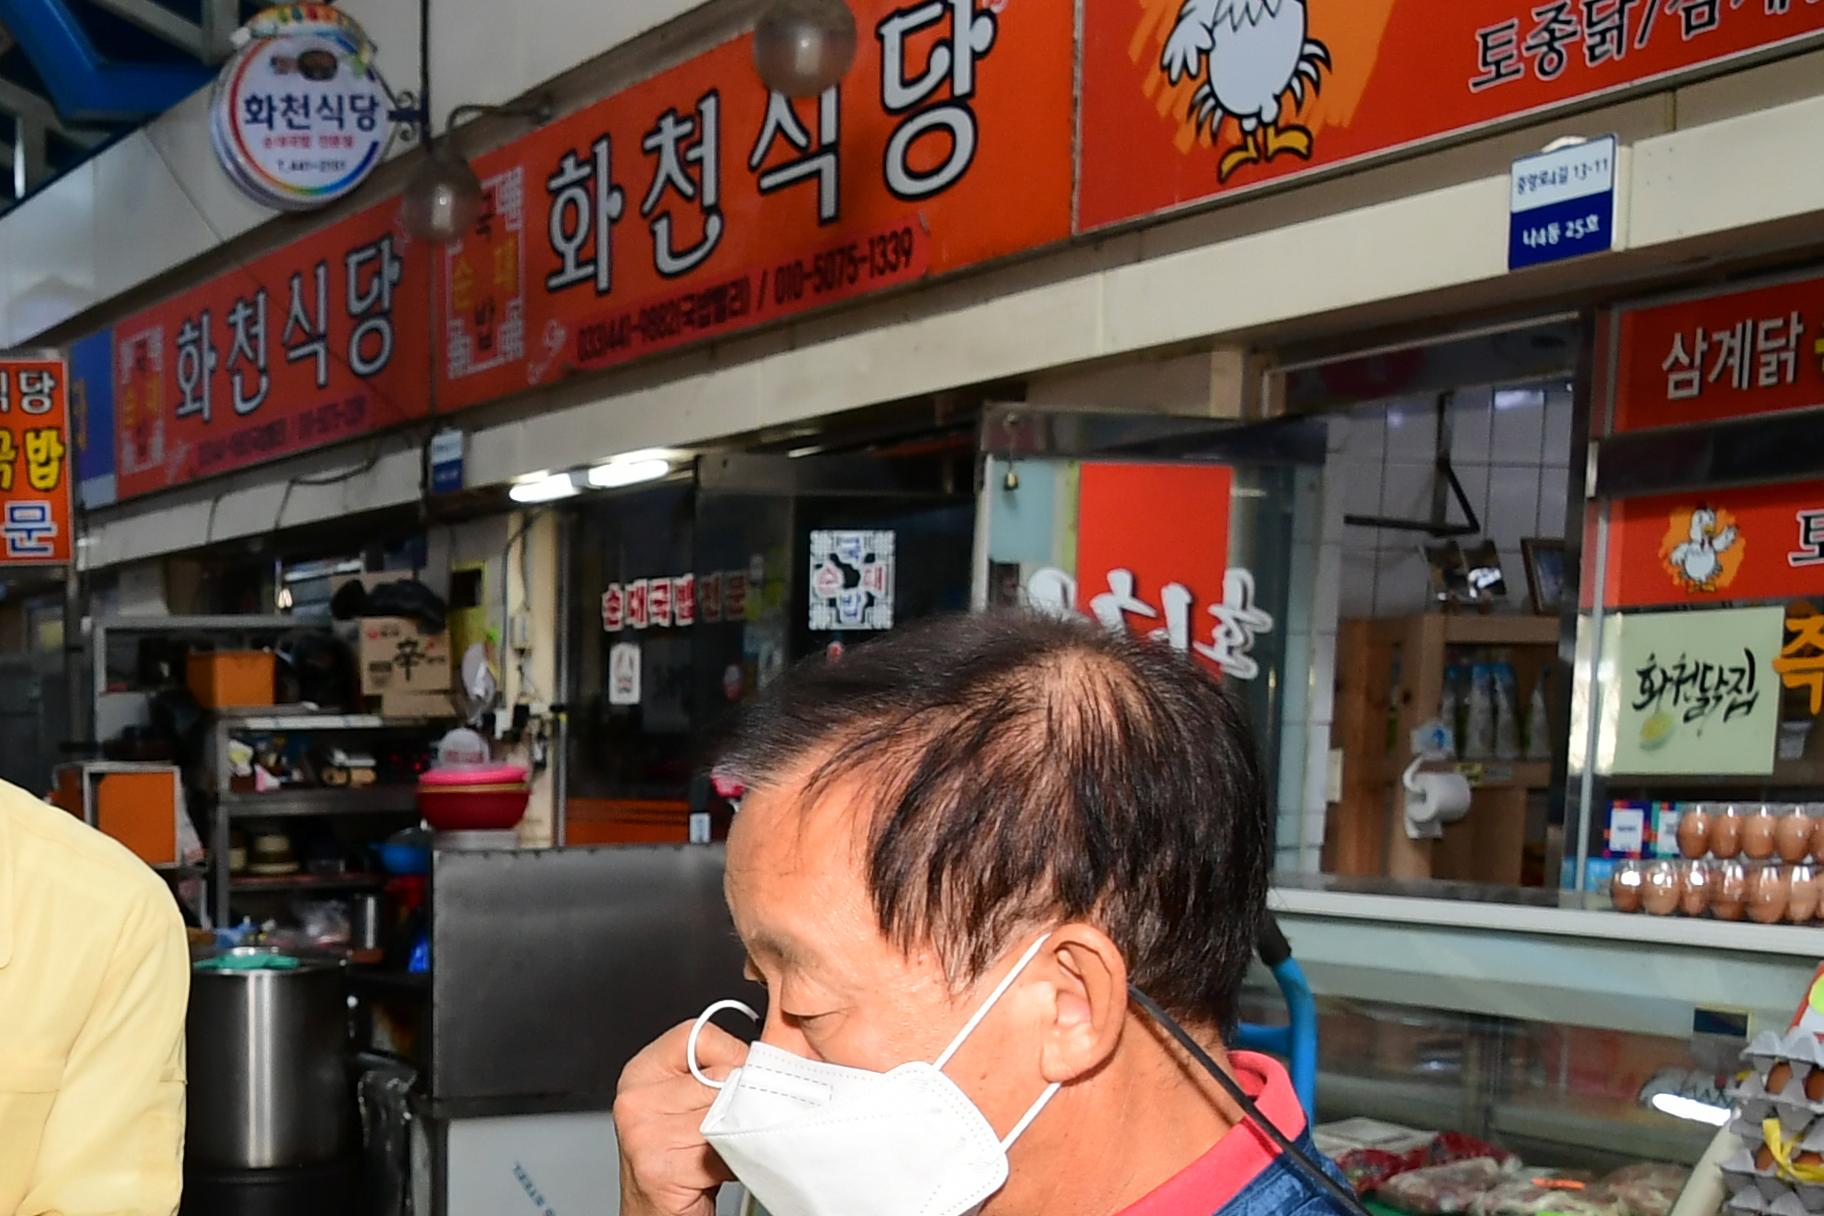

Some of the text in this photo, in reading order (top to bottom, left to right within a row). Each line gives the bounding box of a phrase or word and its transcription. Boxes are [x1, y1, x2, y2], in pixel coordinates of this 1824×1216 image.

[243, 94, 380, 132] 화천식당
[545, 0, 996, 295] 화천식당
[176, 234, 404, 423] 화천식당
[1661, 311, 1804, 400] 삼계닭
